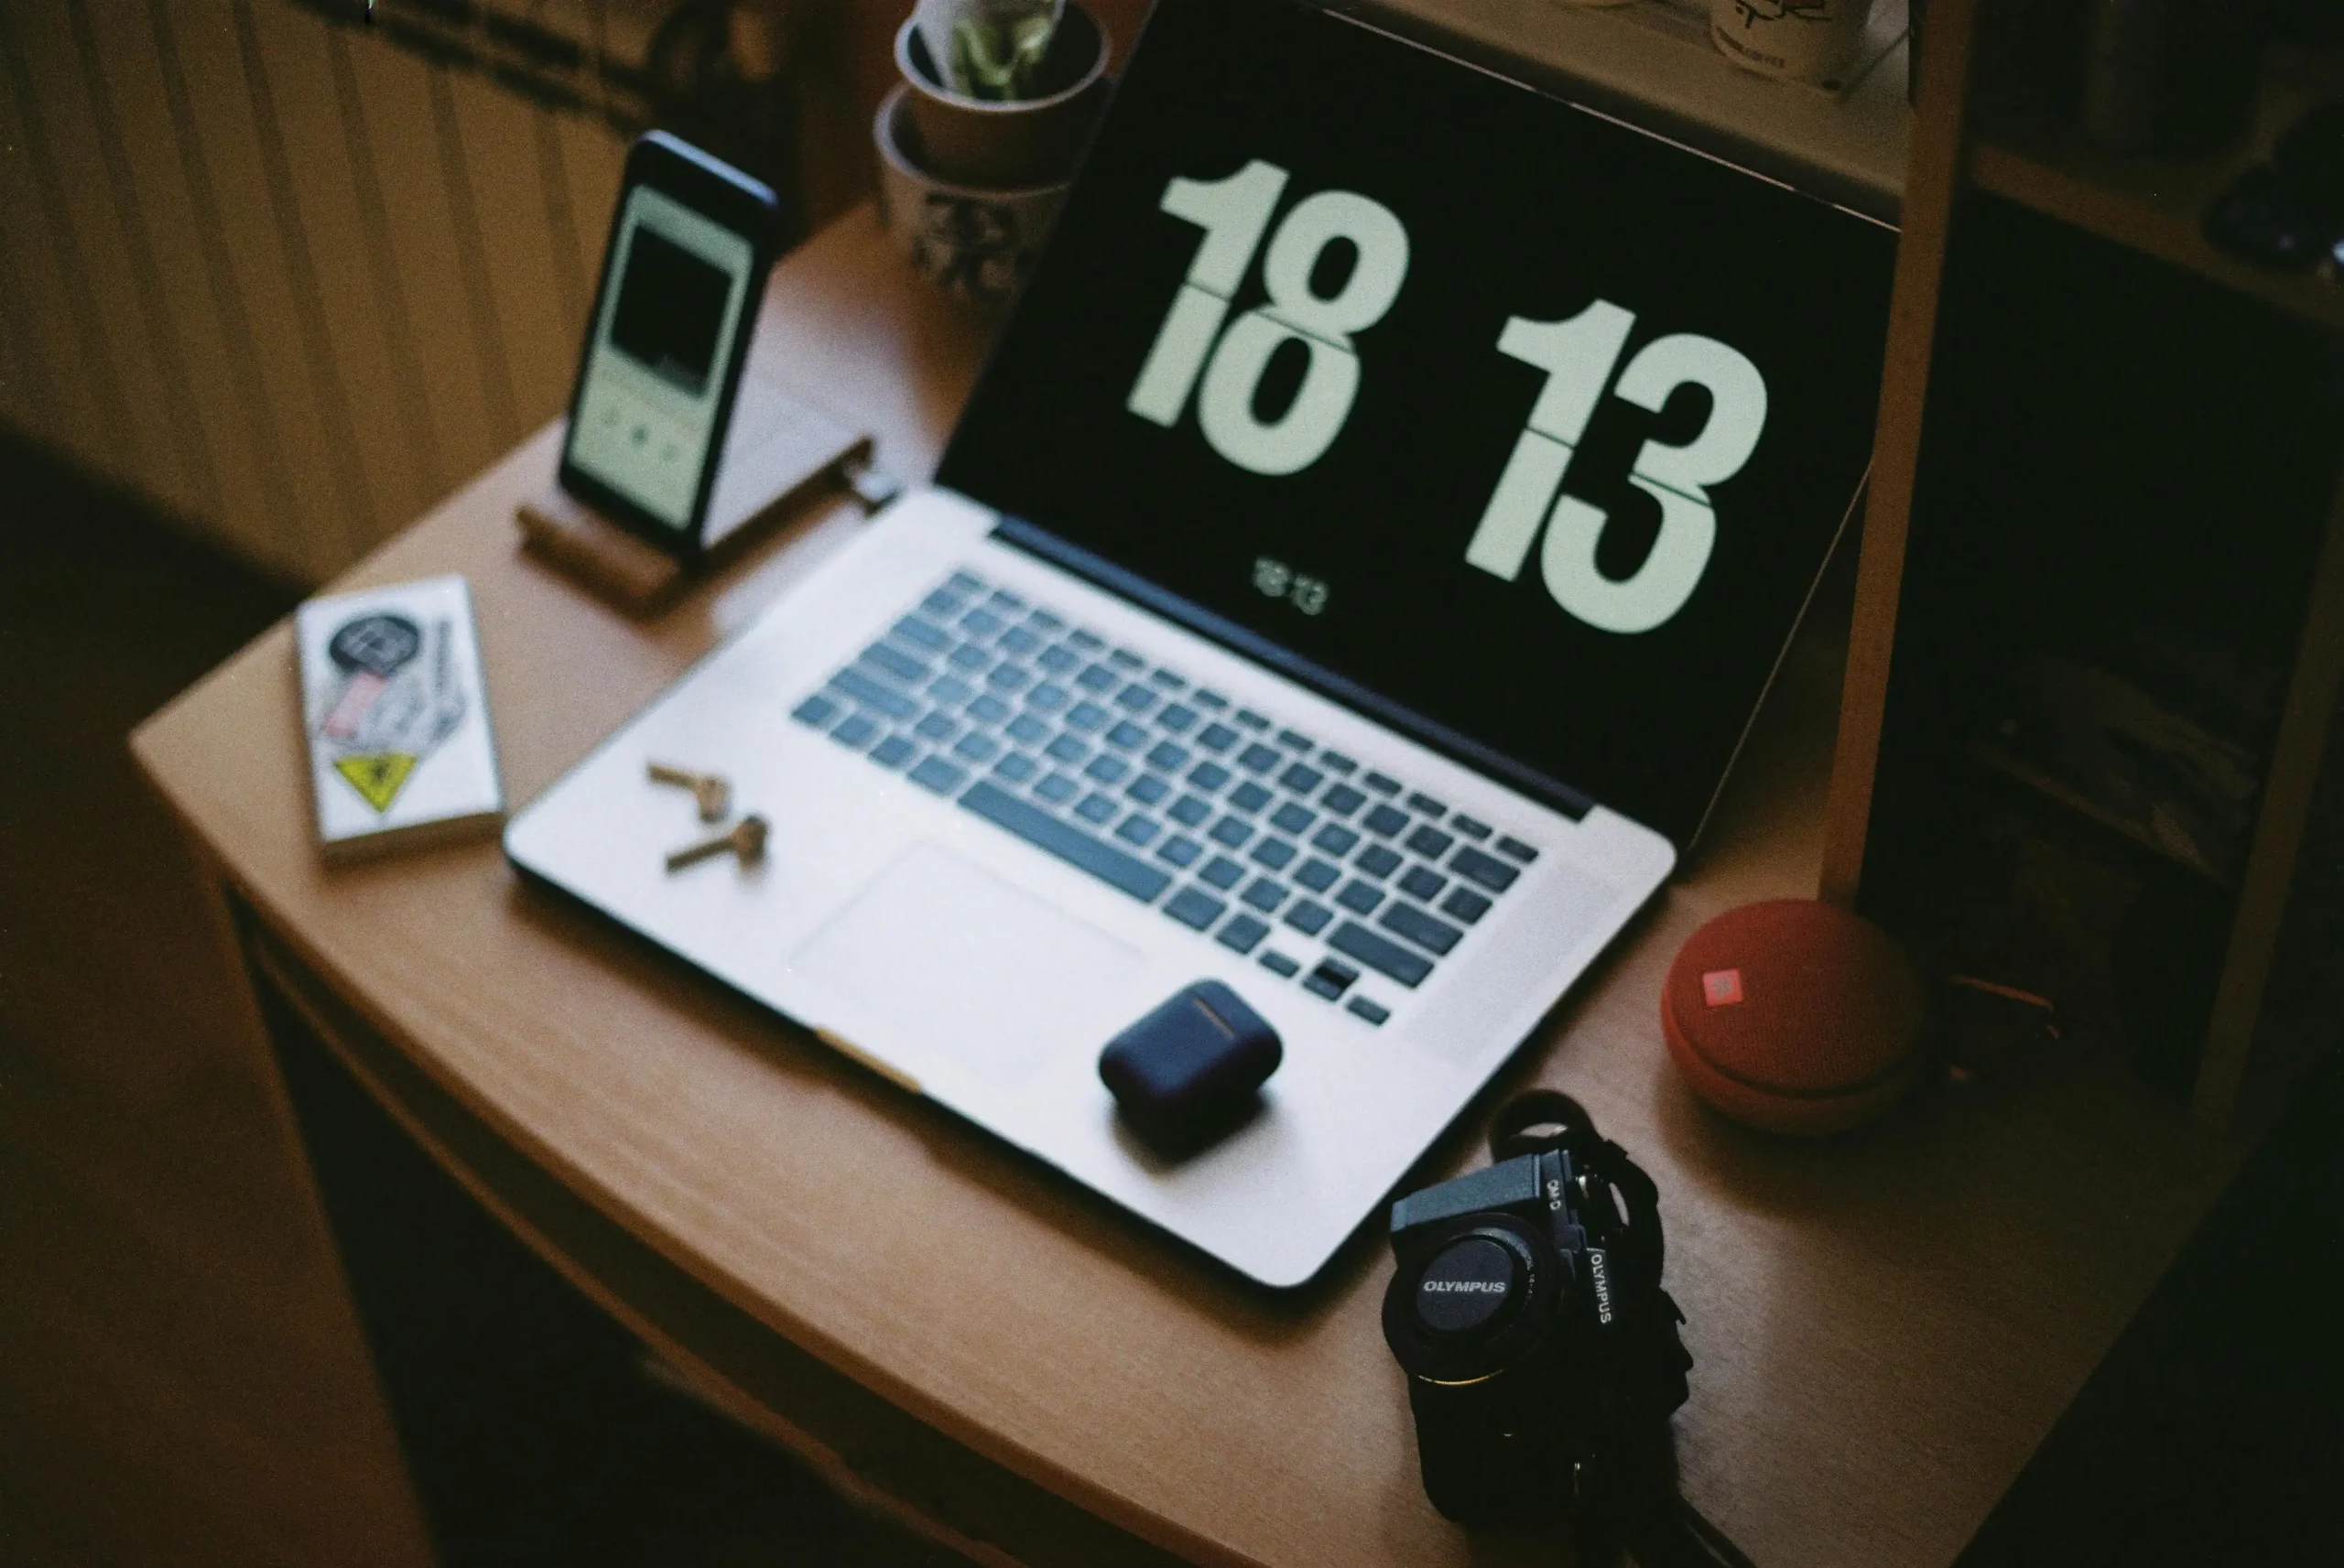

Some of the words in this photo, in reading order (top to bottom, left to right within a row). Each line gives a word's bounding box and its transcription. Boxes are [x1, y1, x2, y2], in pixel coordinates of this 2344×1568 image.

[1127, 159, 1410, 476] 18
[1465, 298, 1769, 634] 13
[1422, 1280, 1507, 1293] OLYMPUS
[1590, 1252, 1612, 1325] OLYMPUS
